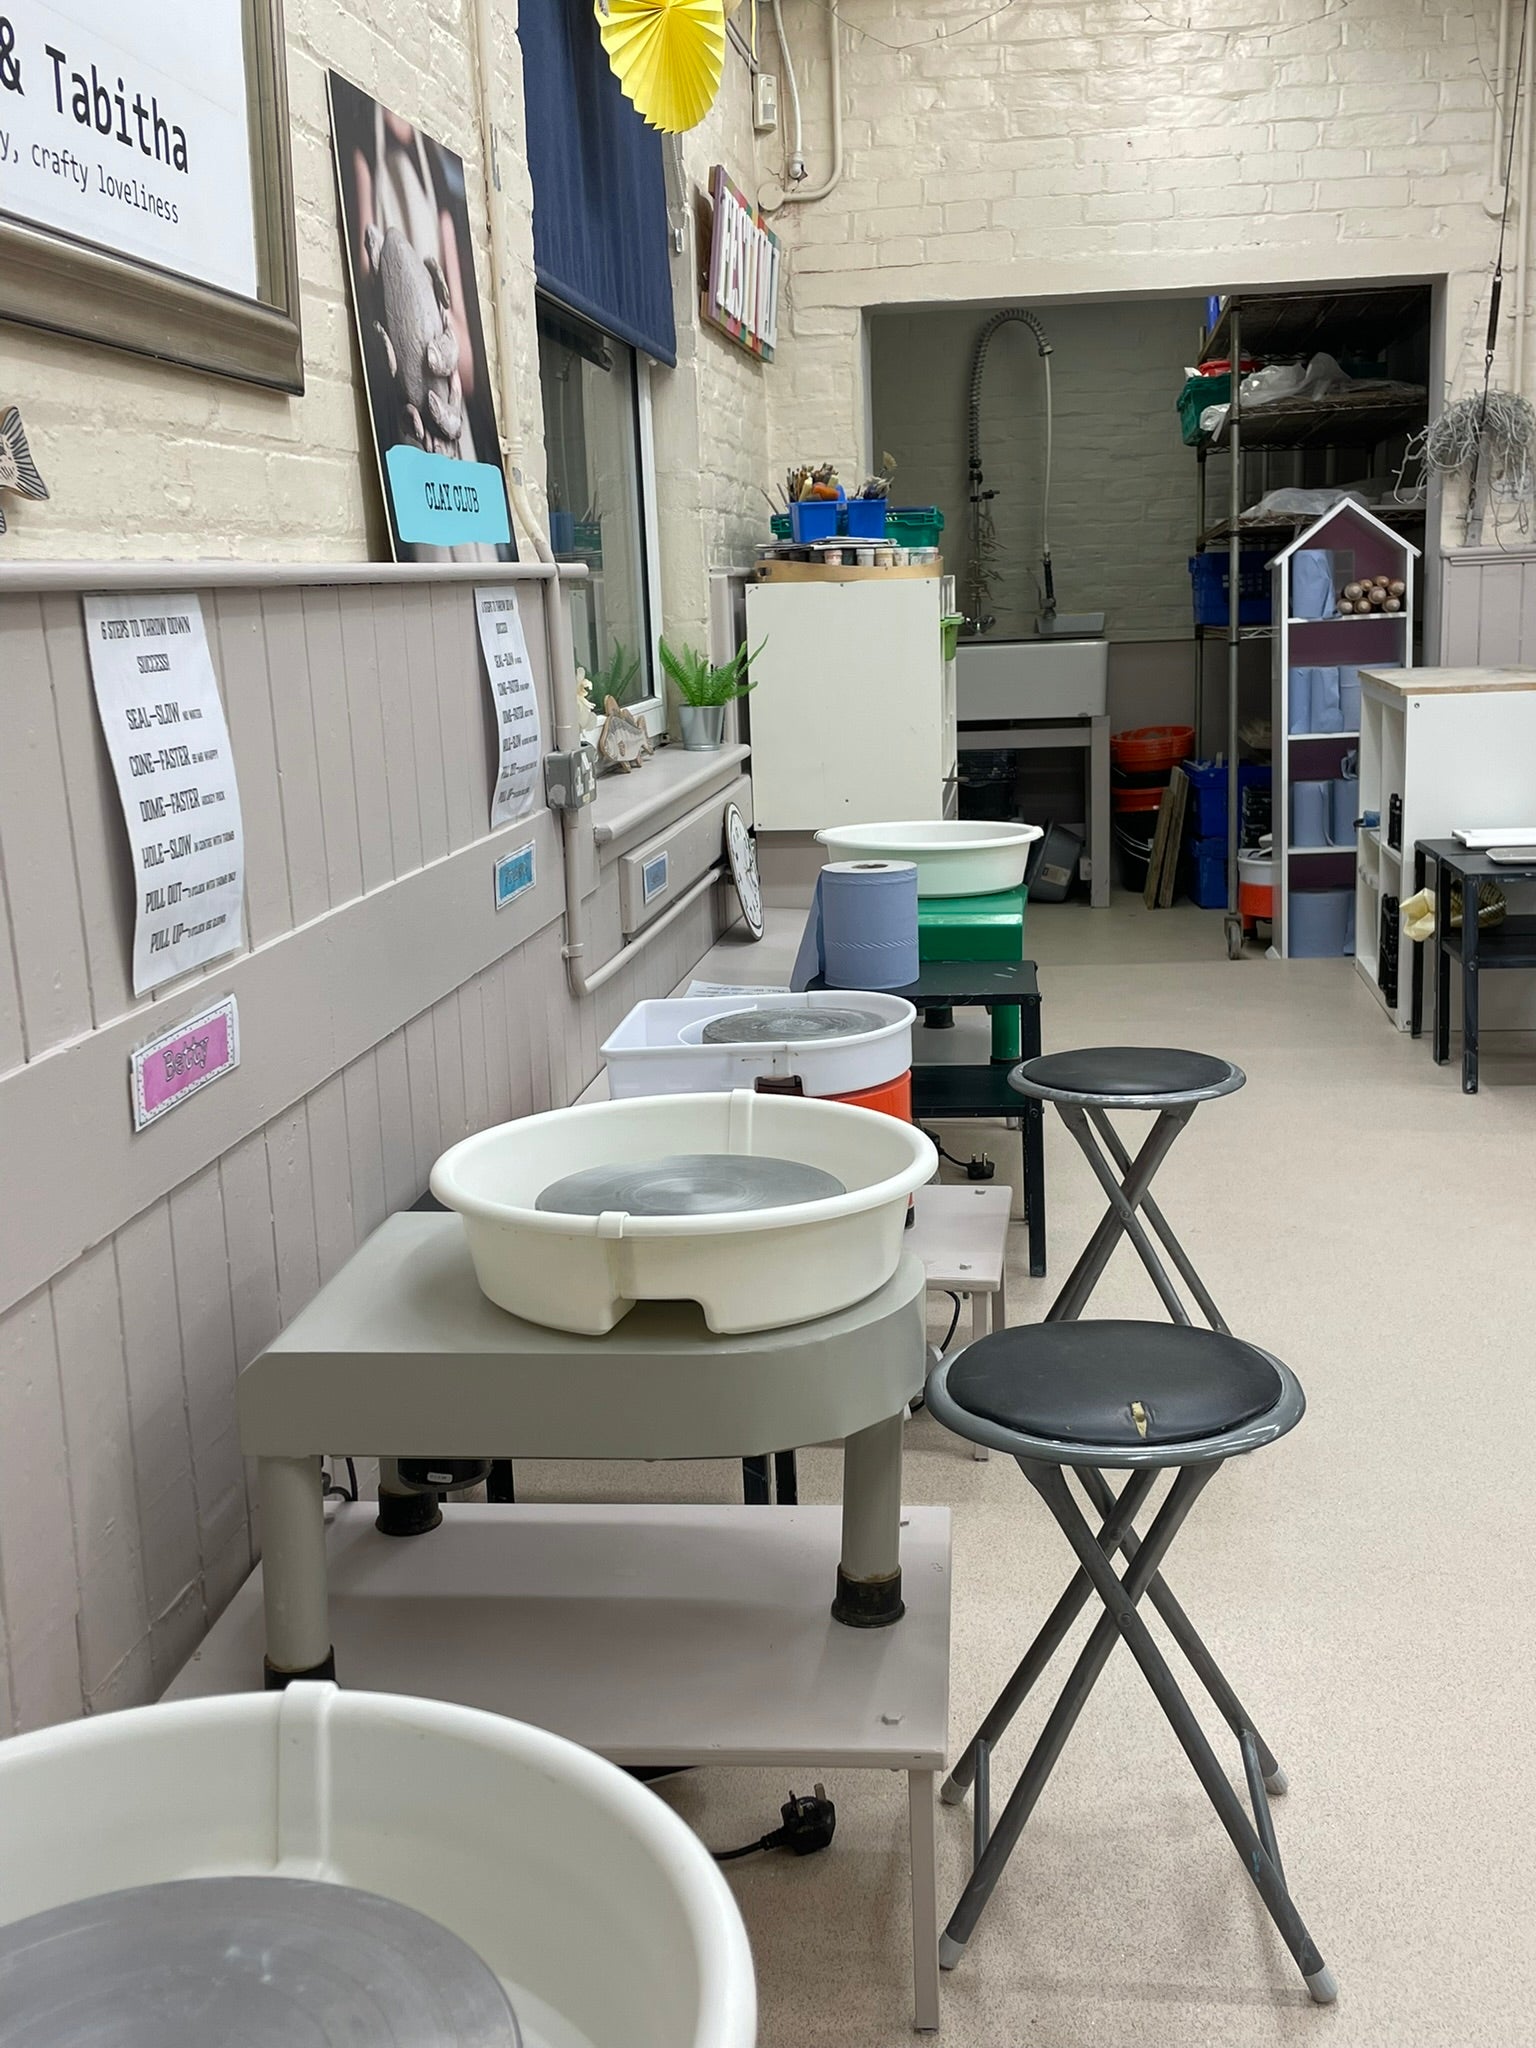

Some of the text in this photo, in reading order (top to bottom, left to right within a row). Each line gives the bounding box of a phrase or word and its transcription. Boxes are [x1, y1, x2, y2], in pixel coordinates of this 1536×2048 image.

[0, 15, 189, 175] & Tabitha
[31, 143, 88, 193] crafty
[97, 163, 179, 224] loveliness
[425, 482, 480, 513] CLAY CLUB
[108, 620, 130, 639] STEPS
[130, 619, 141, 638] TO
[141, 617, 167, 637] THROW
[167, 616, 191, 635] DOWN
[145, 888, 166, 914] PULL
[150, 927, 170, 954] PULL
[162, 1036, 209, 1082] Betty
